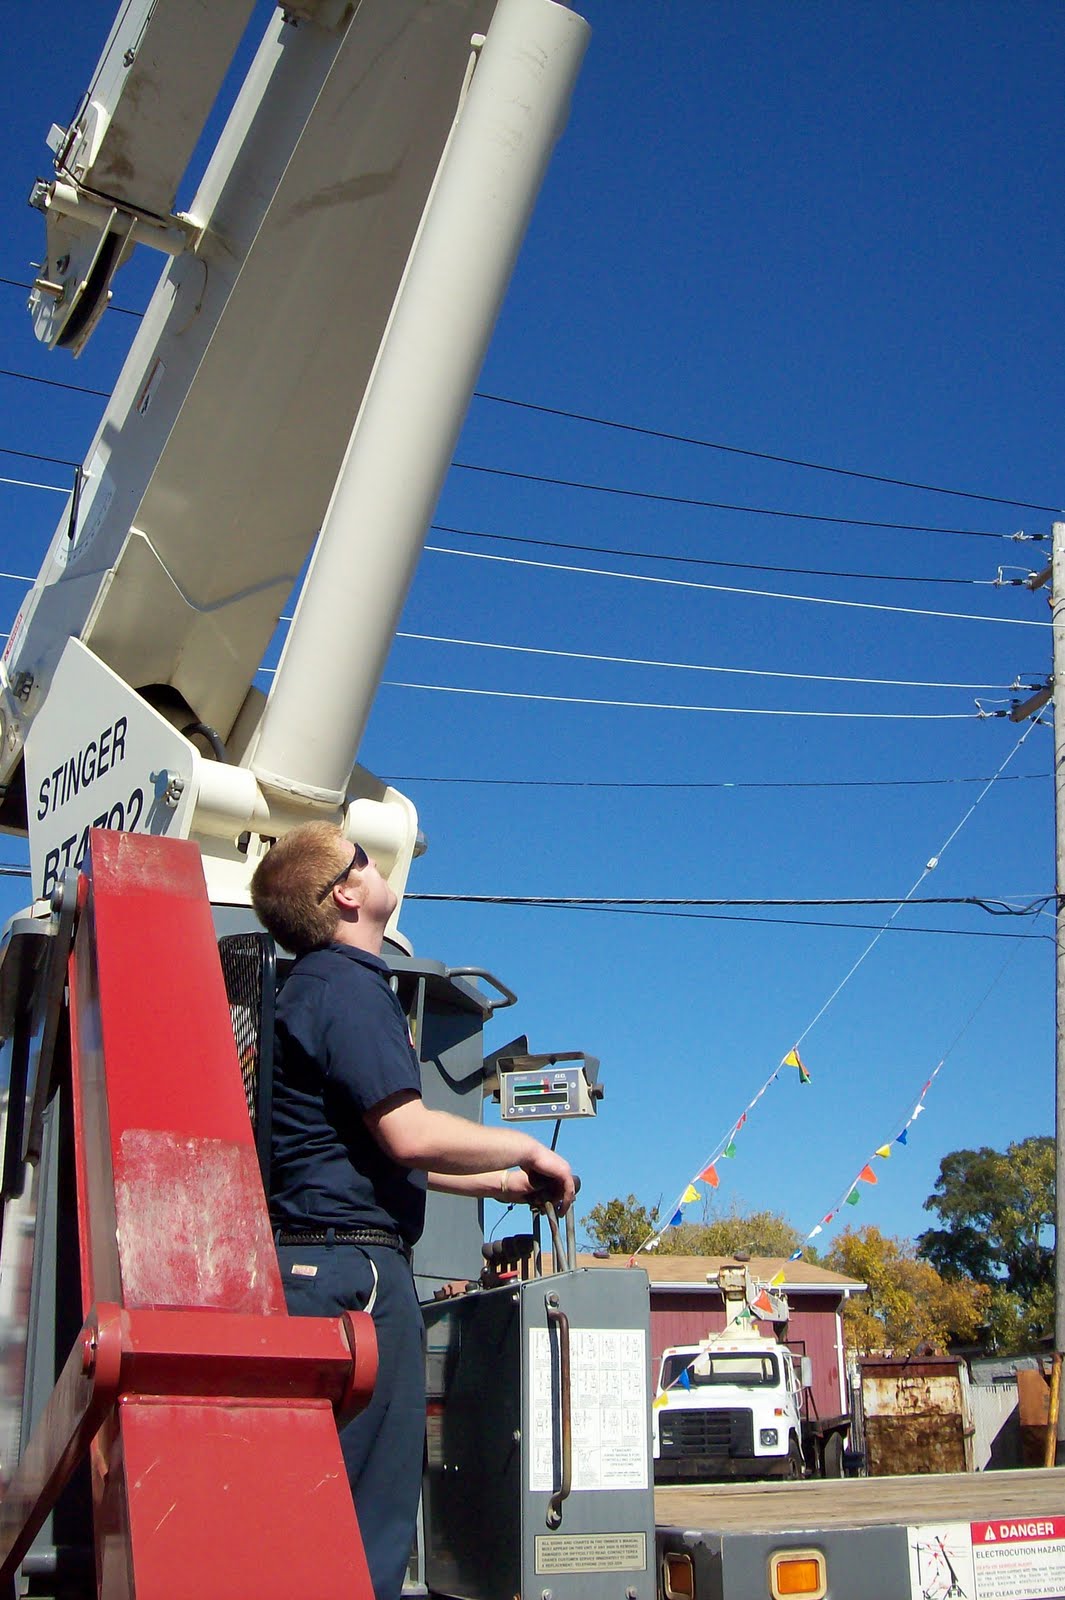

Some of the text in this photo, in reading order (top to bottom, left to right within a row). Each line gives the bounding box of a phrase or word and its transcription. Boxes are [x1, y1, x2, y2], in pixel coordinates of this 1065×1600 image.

[37, 716, 128, 821] STINGER
[1000, 1522, 1054, 1538] DANGER
[976, 1545, 1065, 1558] ELECTROCUTION HAZARD
